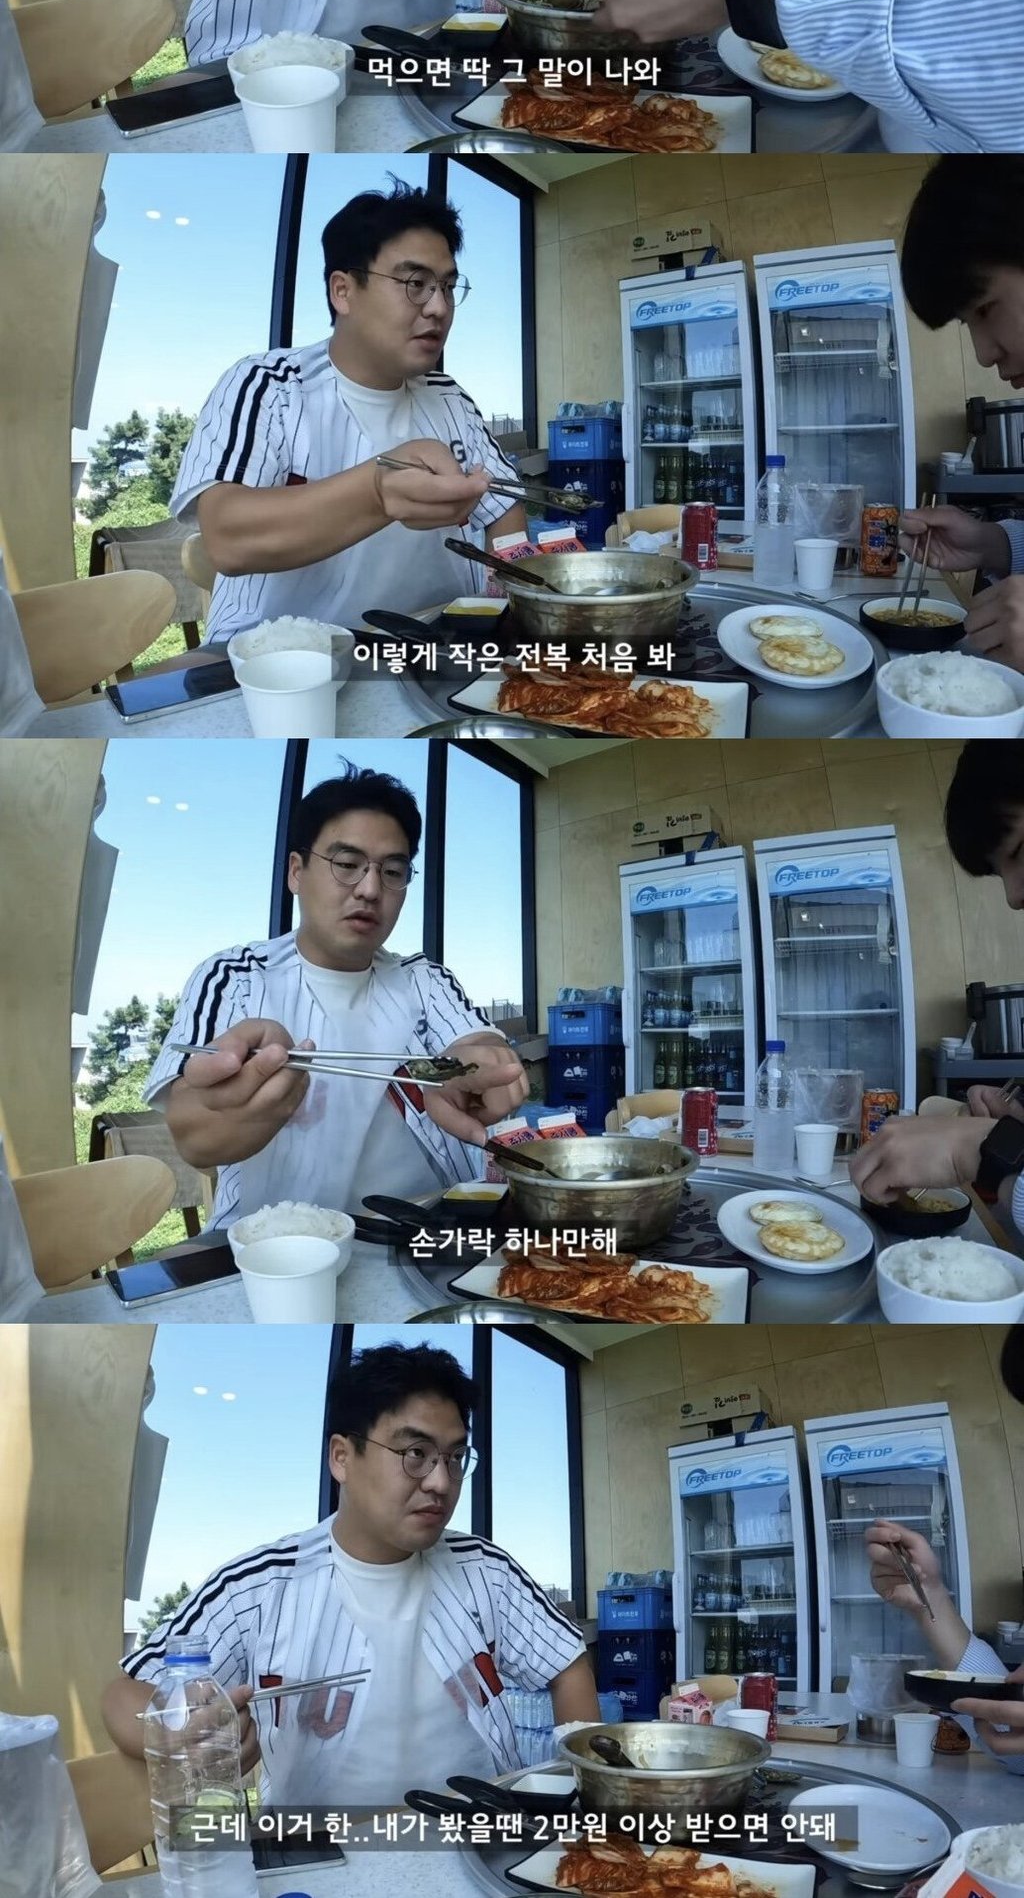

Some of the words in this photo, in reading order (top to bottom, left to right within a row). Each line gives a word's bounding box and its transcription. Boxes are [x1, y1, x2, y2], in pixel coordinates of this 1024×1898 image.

[778, 282, 840, 299] FREETOP
[778, 867, 840, 884] FREETOP
[828, 1446, 892, 1464] FREETOP
